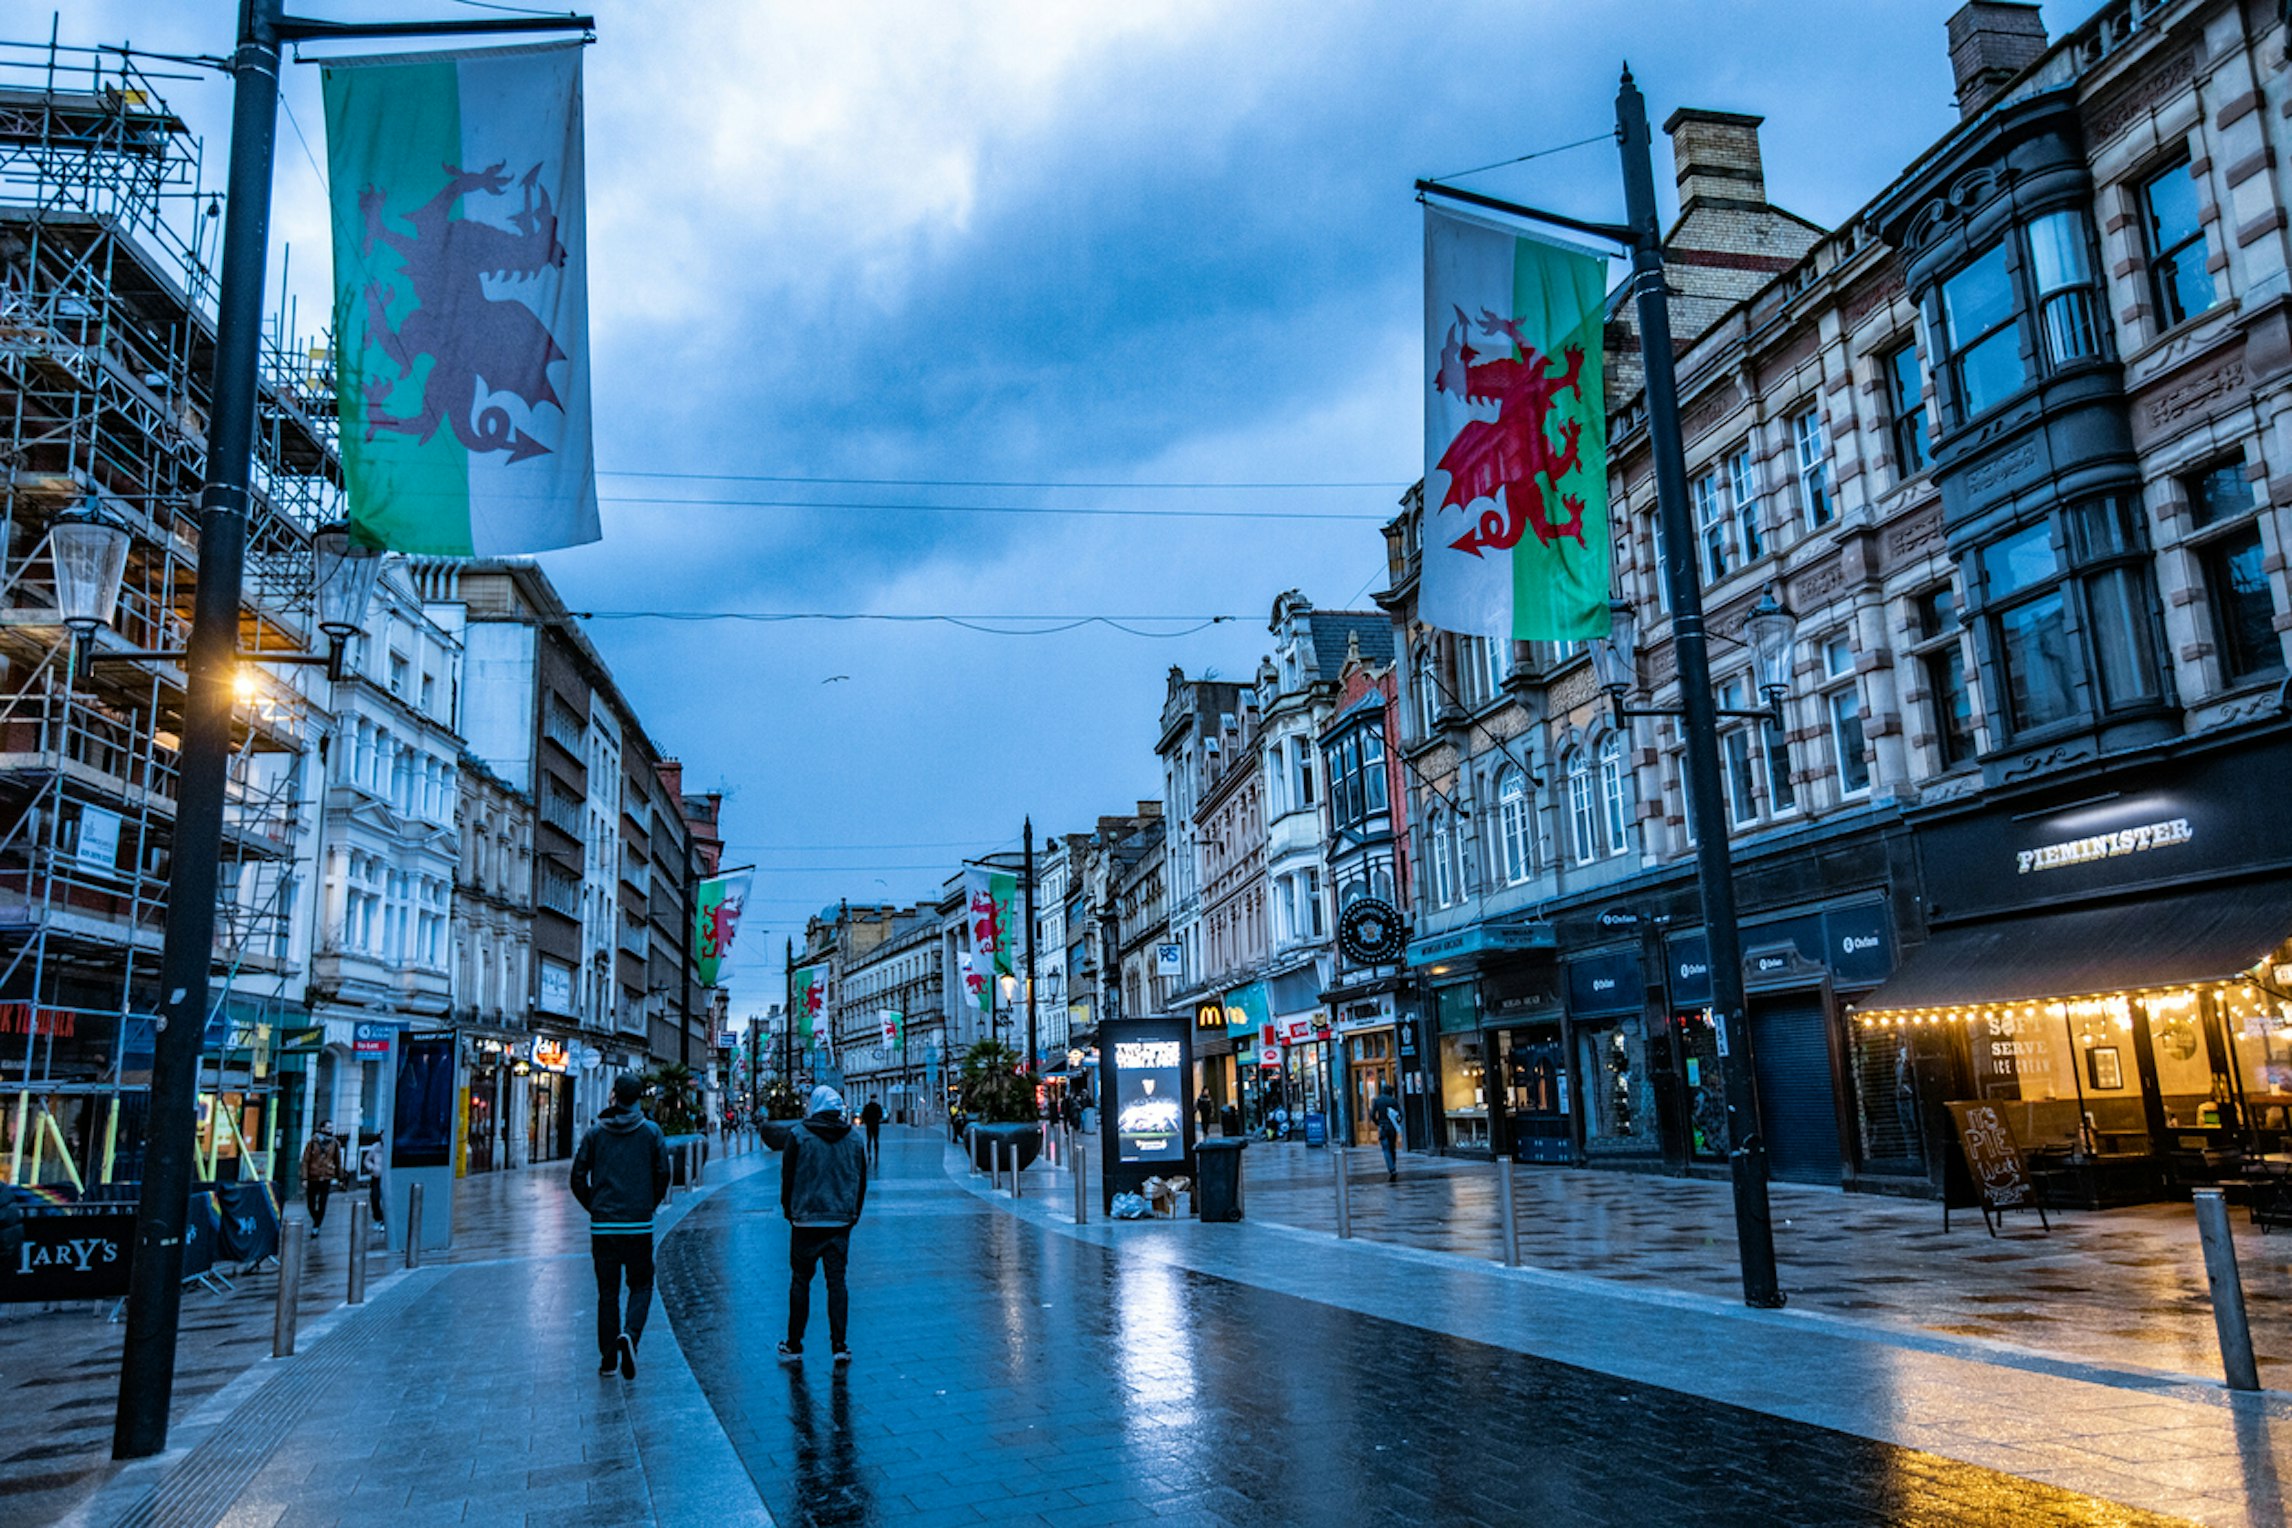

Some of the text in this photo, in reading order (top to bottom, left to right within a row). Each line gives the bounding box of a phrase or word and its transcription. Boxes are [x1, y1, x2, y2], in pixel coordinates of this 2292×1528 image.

[2016, 818, 2193, 874] PIEMINISTER
[1611, 915, 1638, 924] Oxfam
[1854, 936, 1879, 949] Oxfam
[1991, 1040, 2048, 1056] SERVE
[1993, 1059, 2050, 1074] ICE CREAM
[1965, 1106, 1999, 1130] IT'S
[1964, 1127, 2014, 1160] PIE
